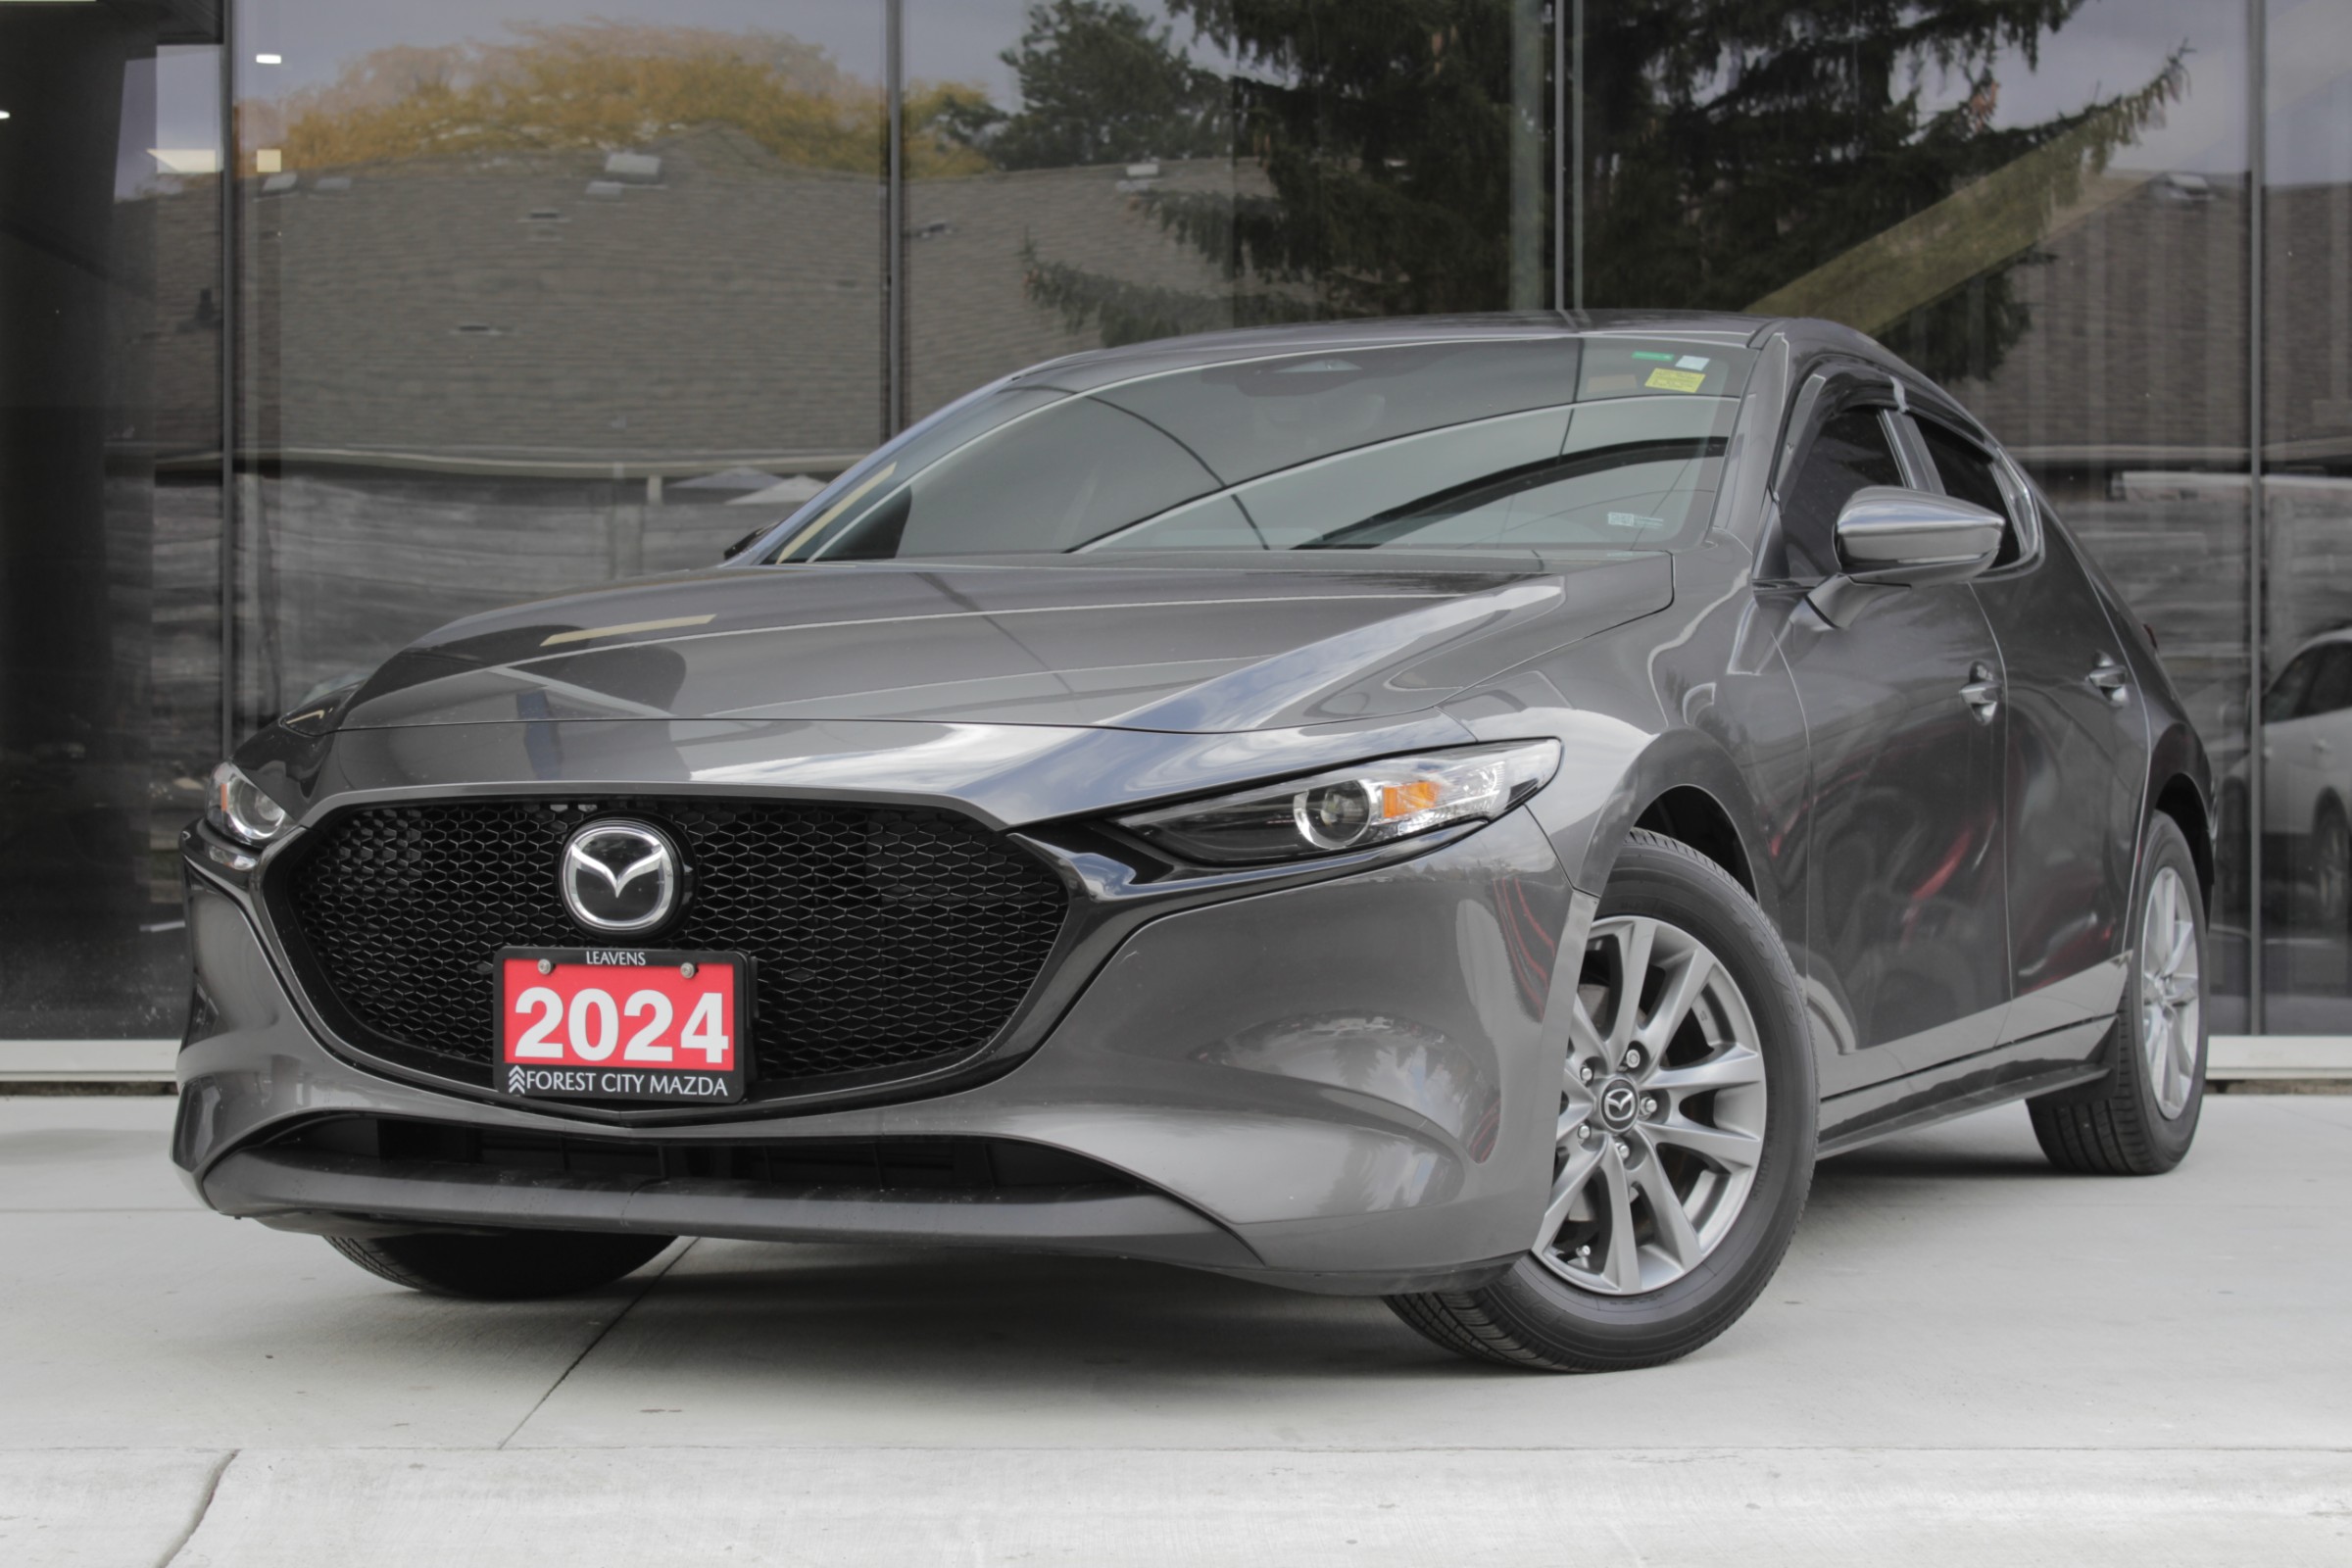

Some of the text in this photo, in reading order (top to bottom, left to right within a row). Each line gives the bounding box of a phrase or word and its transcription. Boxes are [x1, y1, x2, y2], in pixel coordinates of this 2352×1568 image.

[586, 951, 647, 966] LEAVENS
[514, 986, 729, 1063] 2024
[525, 1070, 729, 1097] FOREST CITY MAZDA
